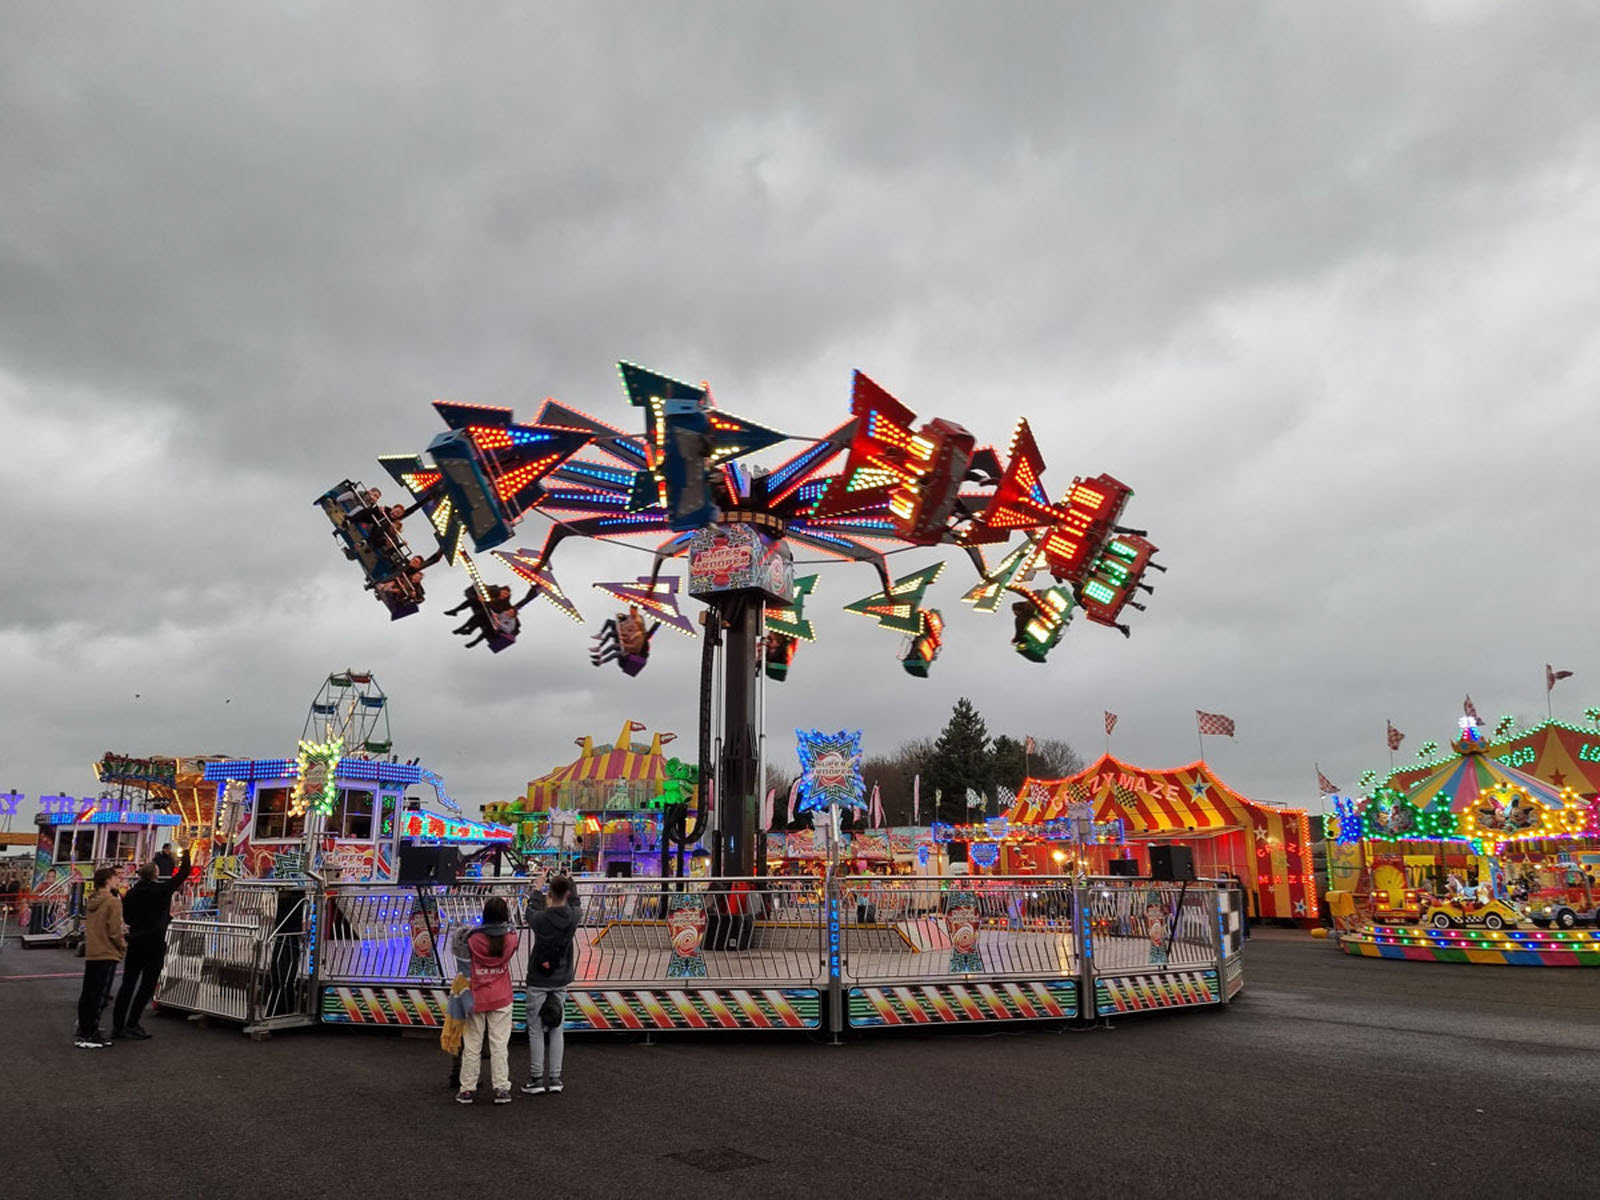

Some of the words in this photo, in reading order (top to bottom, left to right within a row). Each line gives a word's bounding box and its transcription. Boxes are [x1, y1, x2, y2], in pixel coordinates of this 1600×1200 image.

[701, 548, 742, 559] SUPER
[694, 557, 750, 569] TROOPER
[1051, 772, 1116, 812] CRZY
[1119, 772, 1180, 802] MAZE
[1257, 842, 1306, 858] CRAZY
[1258, 874, 1309, 885] MAZE
[830, 899, 840, 977] TROOPER
